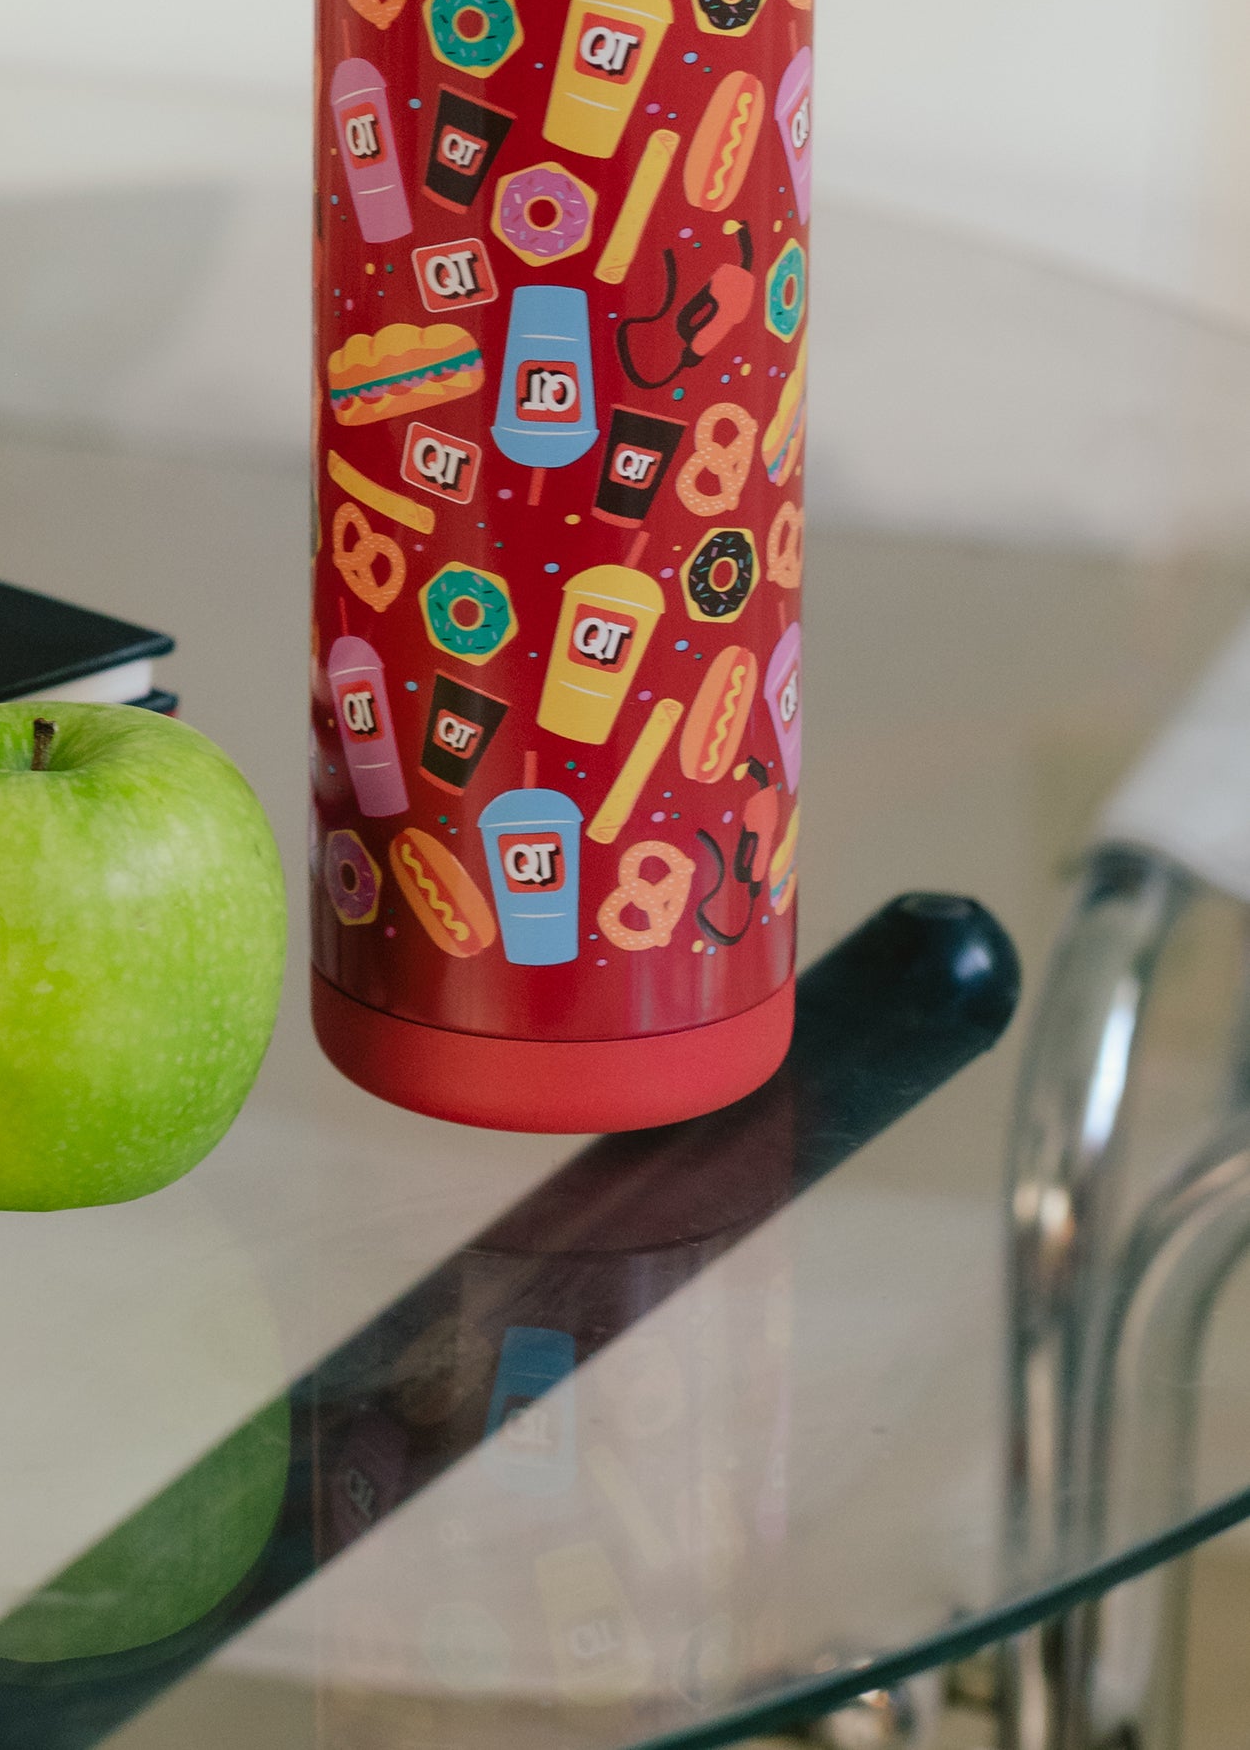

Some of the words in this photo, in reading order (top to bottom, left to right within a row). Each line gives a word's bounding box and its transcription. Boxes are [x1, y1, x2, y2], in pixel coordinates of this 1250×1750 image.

[580, 26, 640, 71] QT
[346, 114, 376, 156] QT
[442, 134, 481, 167] QT
[425, 251, 475, 296] QT
[523, 371, 577, 412] QT
[413, 438, 467, 484] QT
[615, 450, 654, 480] QT
[573, 617, 630, 659] QT
[343, 691, 373, 731] QT
[437, 717, 477, 749] QT
[505, 843, 556, 883] QT
